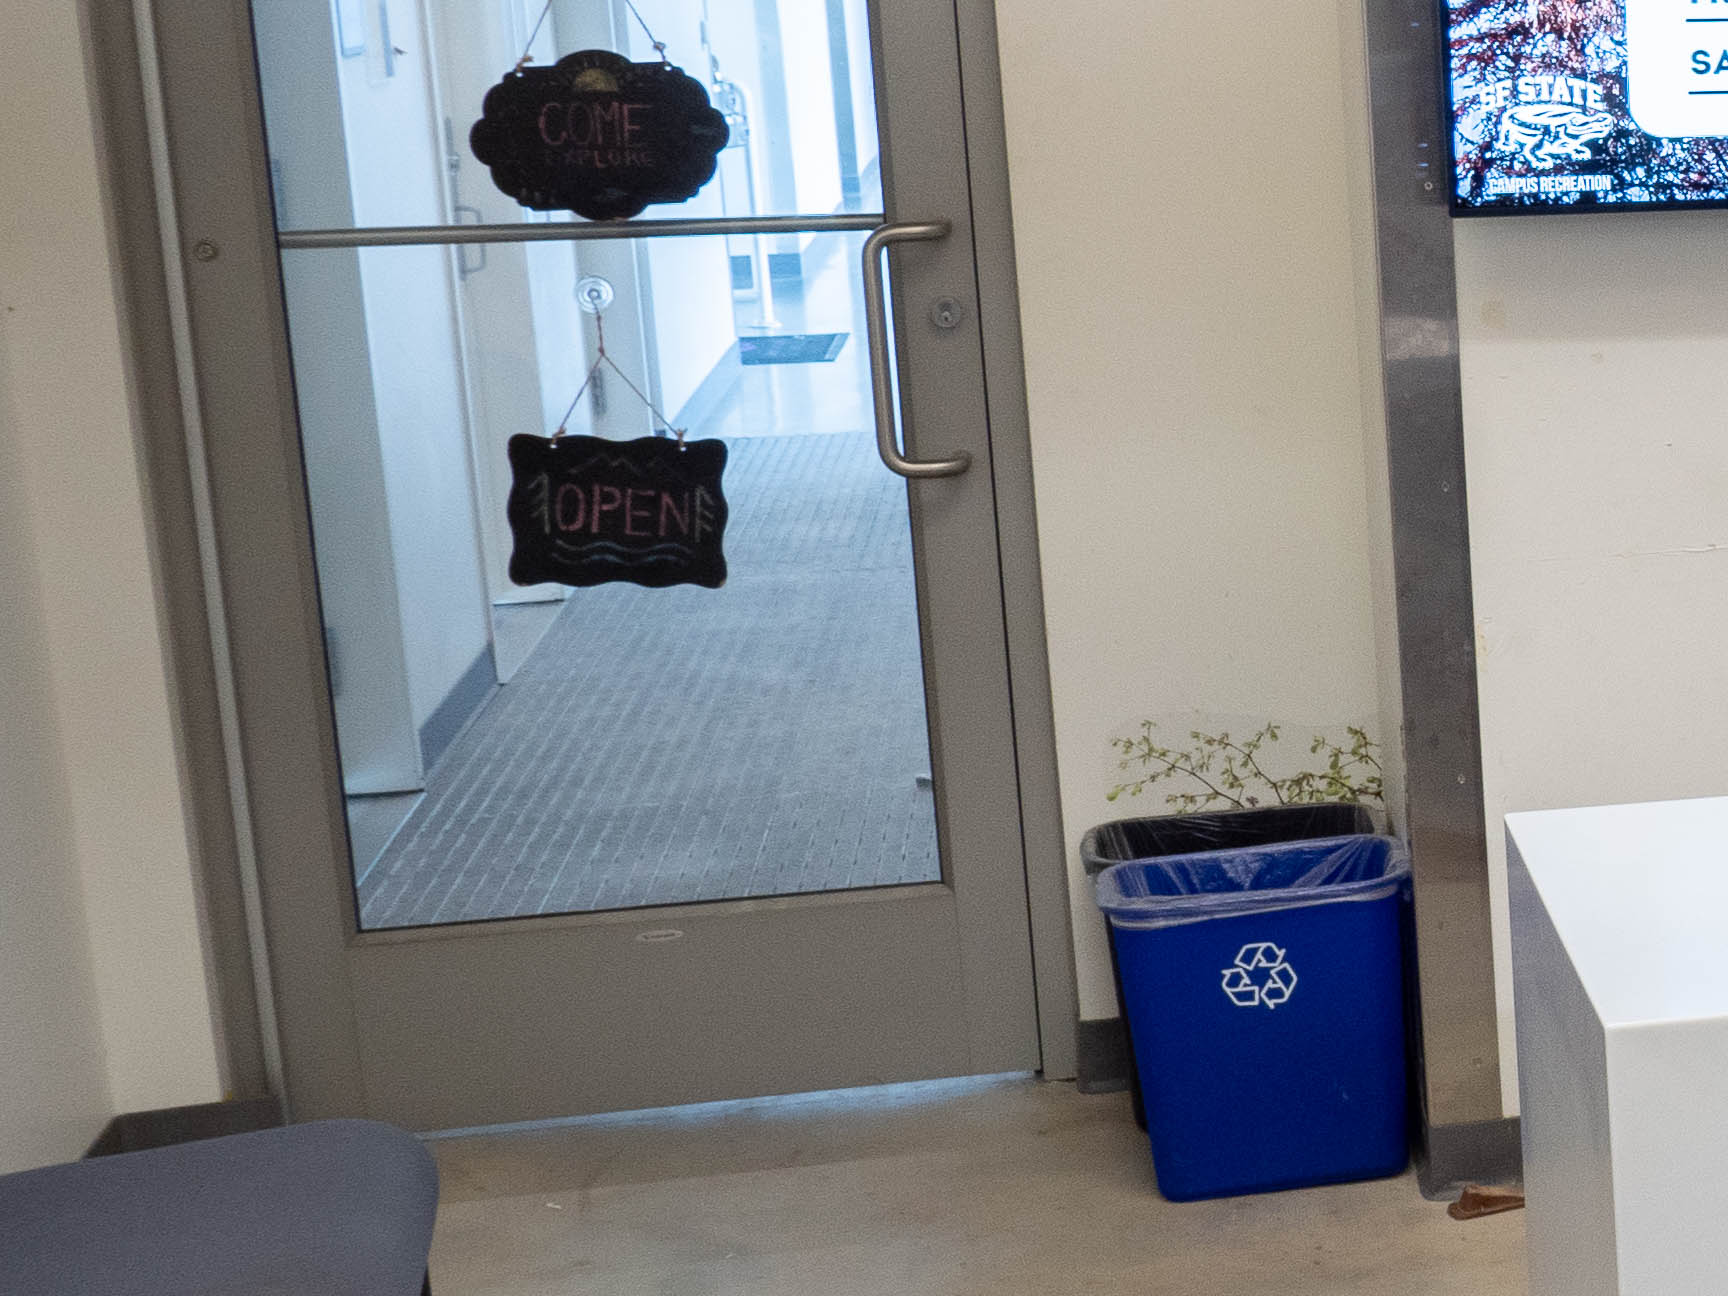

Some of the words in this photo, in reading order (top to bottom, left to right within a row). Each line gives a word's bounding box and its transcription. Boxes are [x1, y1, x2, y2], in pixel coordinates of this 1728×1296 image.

[1479, 78, 1513, 111] SF
[1517, 75, 1606, 111] STATE
[539, 102, 654, 147] COME
[1488, 176, 1539, 194] CAMPUS
[1540, 174, 1612, 193] RECREATION
[555, 482, 690, 539] OPEN
